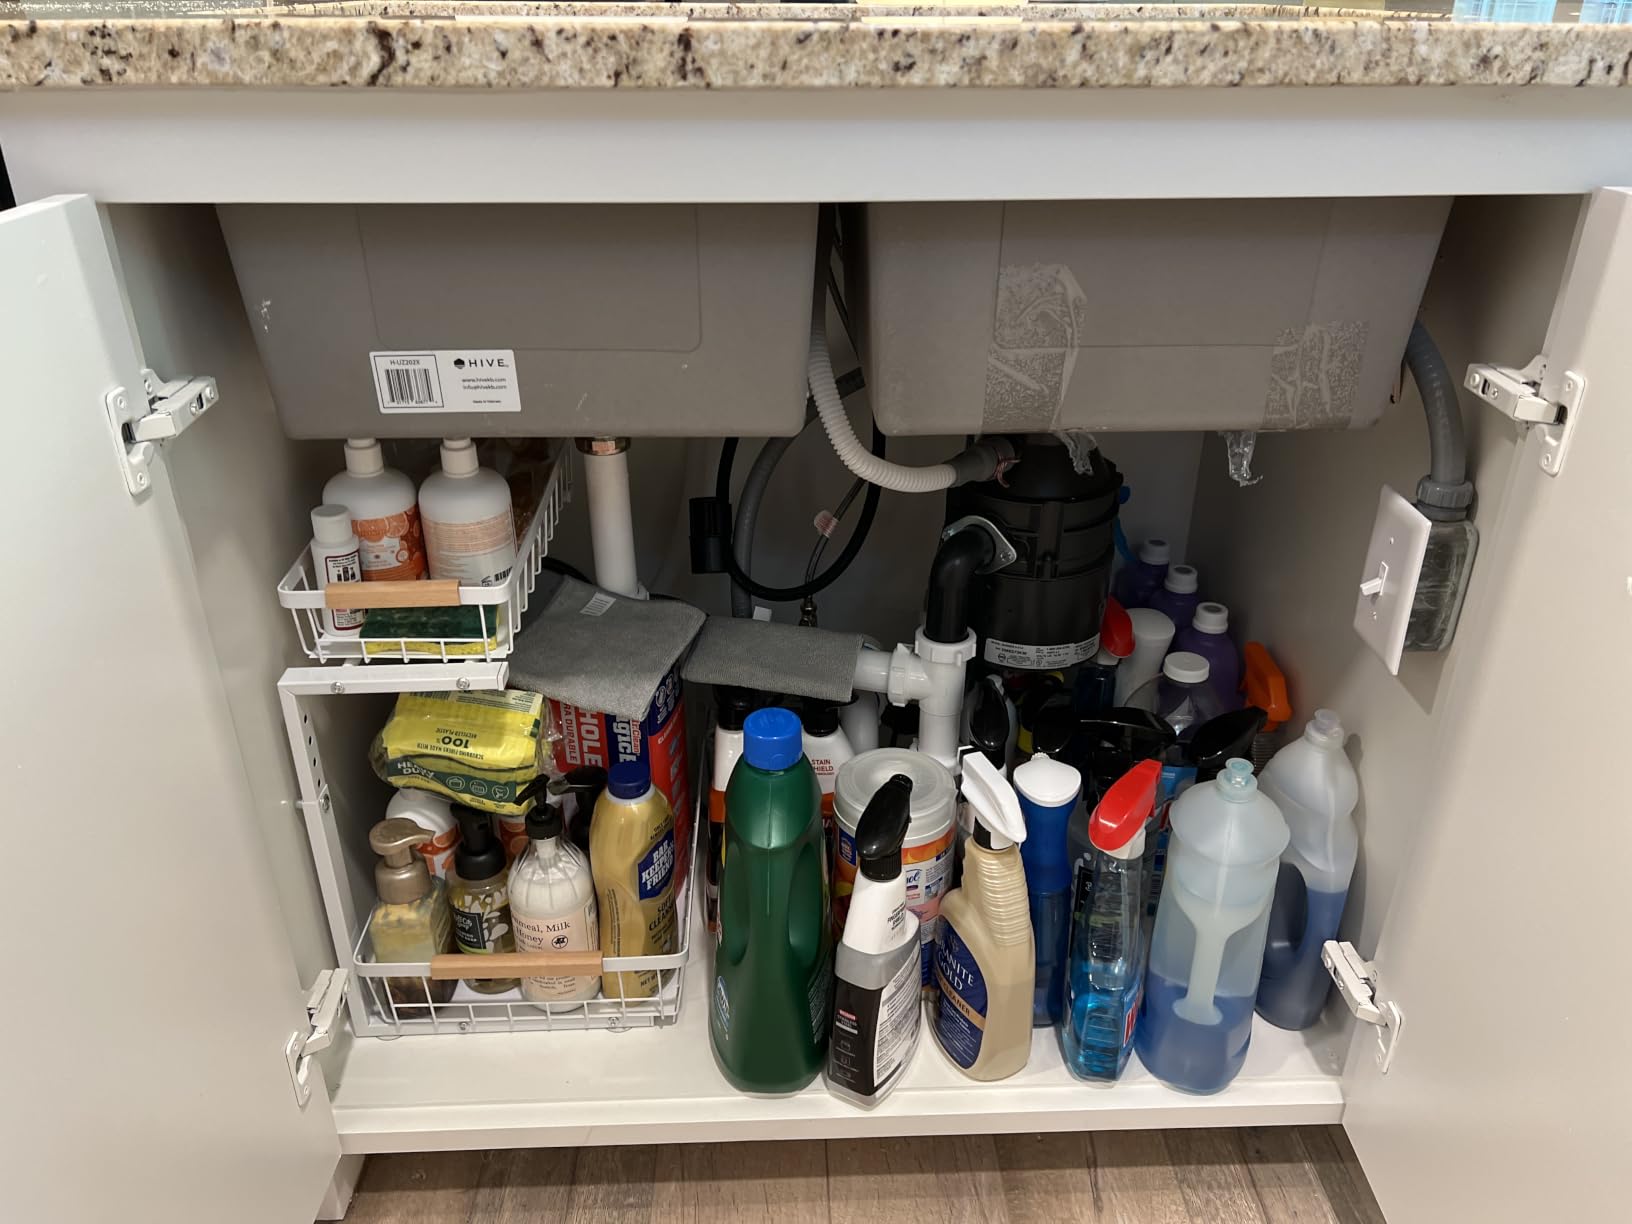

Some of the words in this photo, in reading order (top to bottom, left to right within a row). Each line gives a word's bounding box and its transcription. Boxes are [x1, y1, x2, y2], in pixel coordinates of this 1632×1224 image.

[468, 358, 505, 368] HIVE
[564, 717, 578, 762] DURABLE
[579, 709, 602, 768] HOLE
[653, 839, 668, 863] BAR
[546, 921, 571, 933] Milk
[938, 954, 963, 991] GOLD
